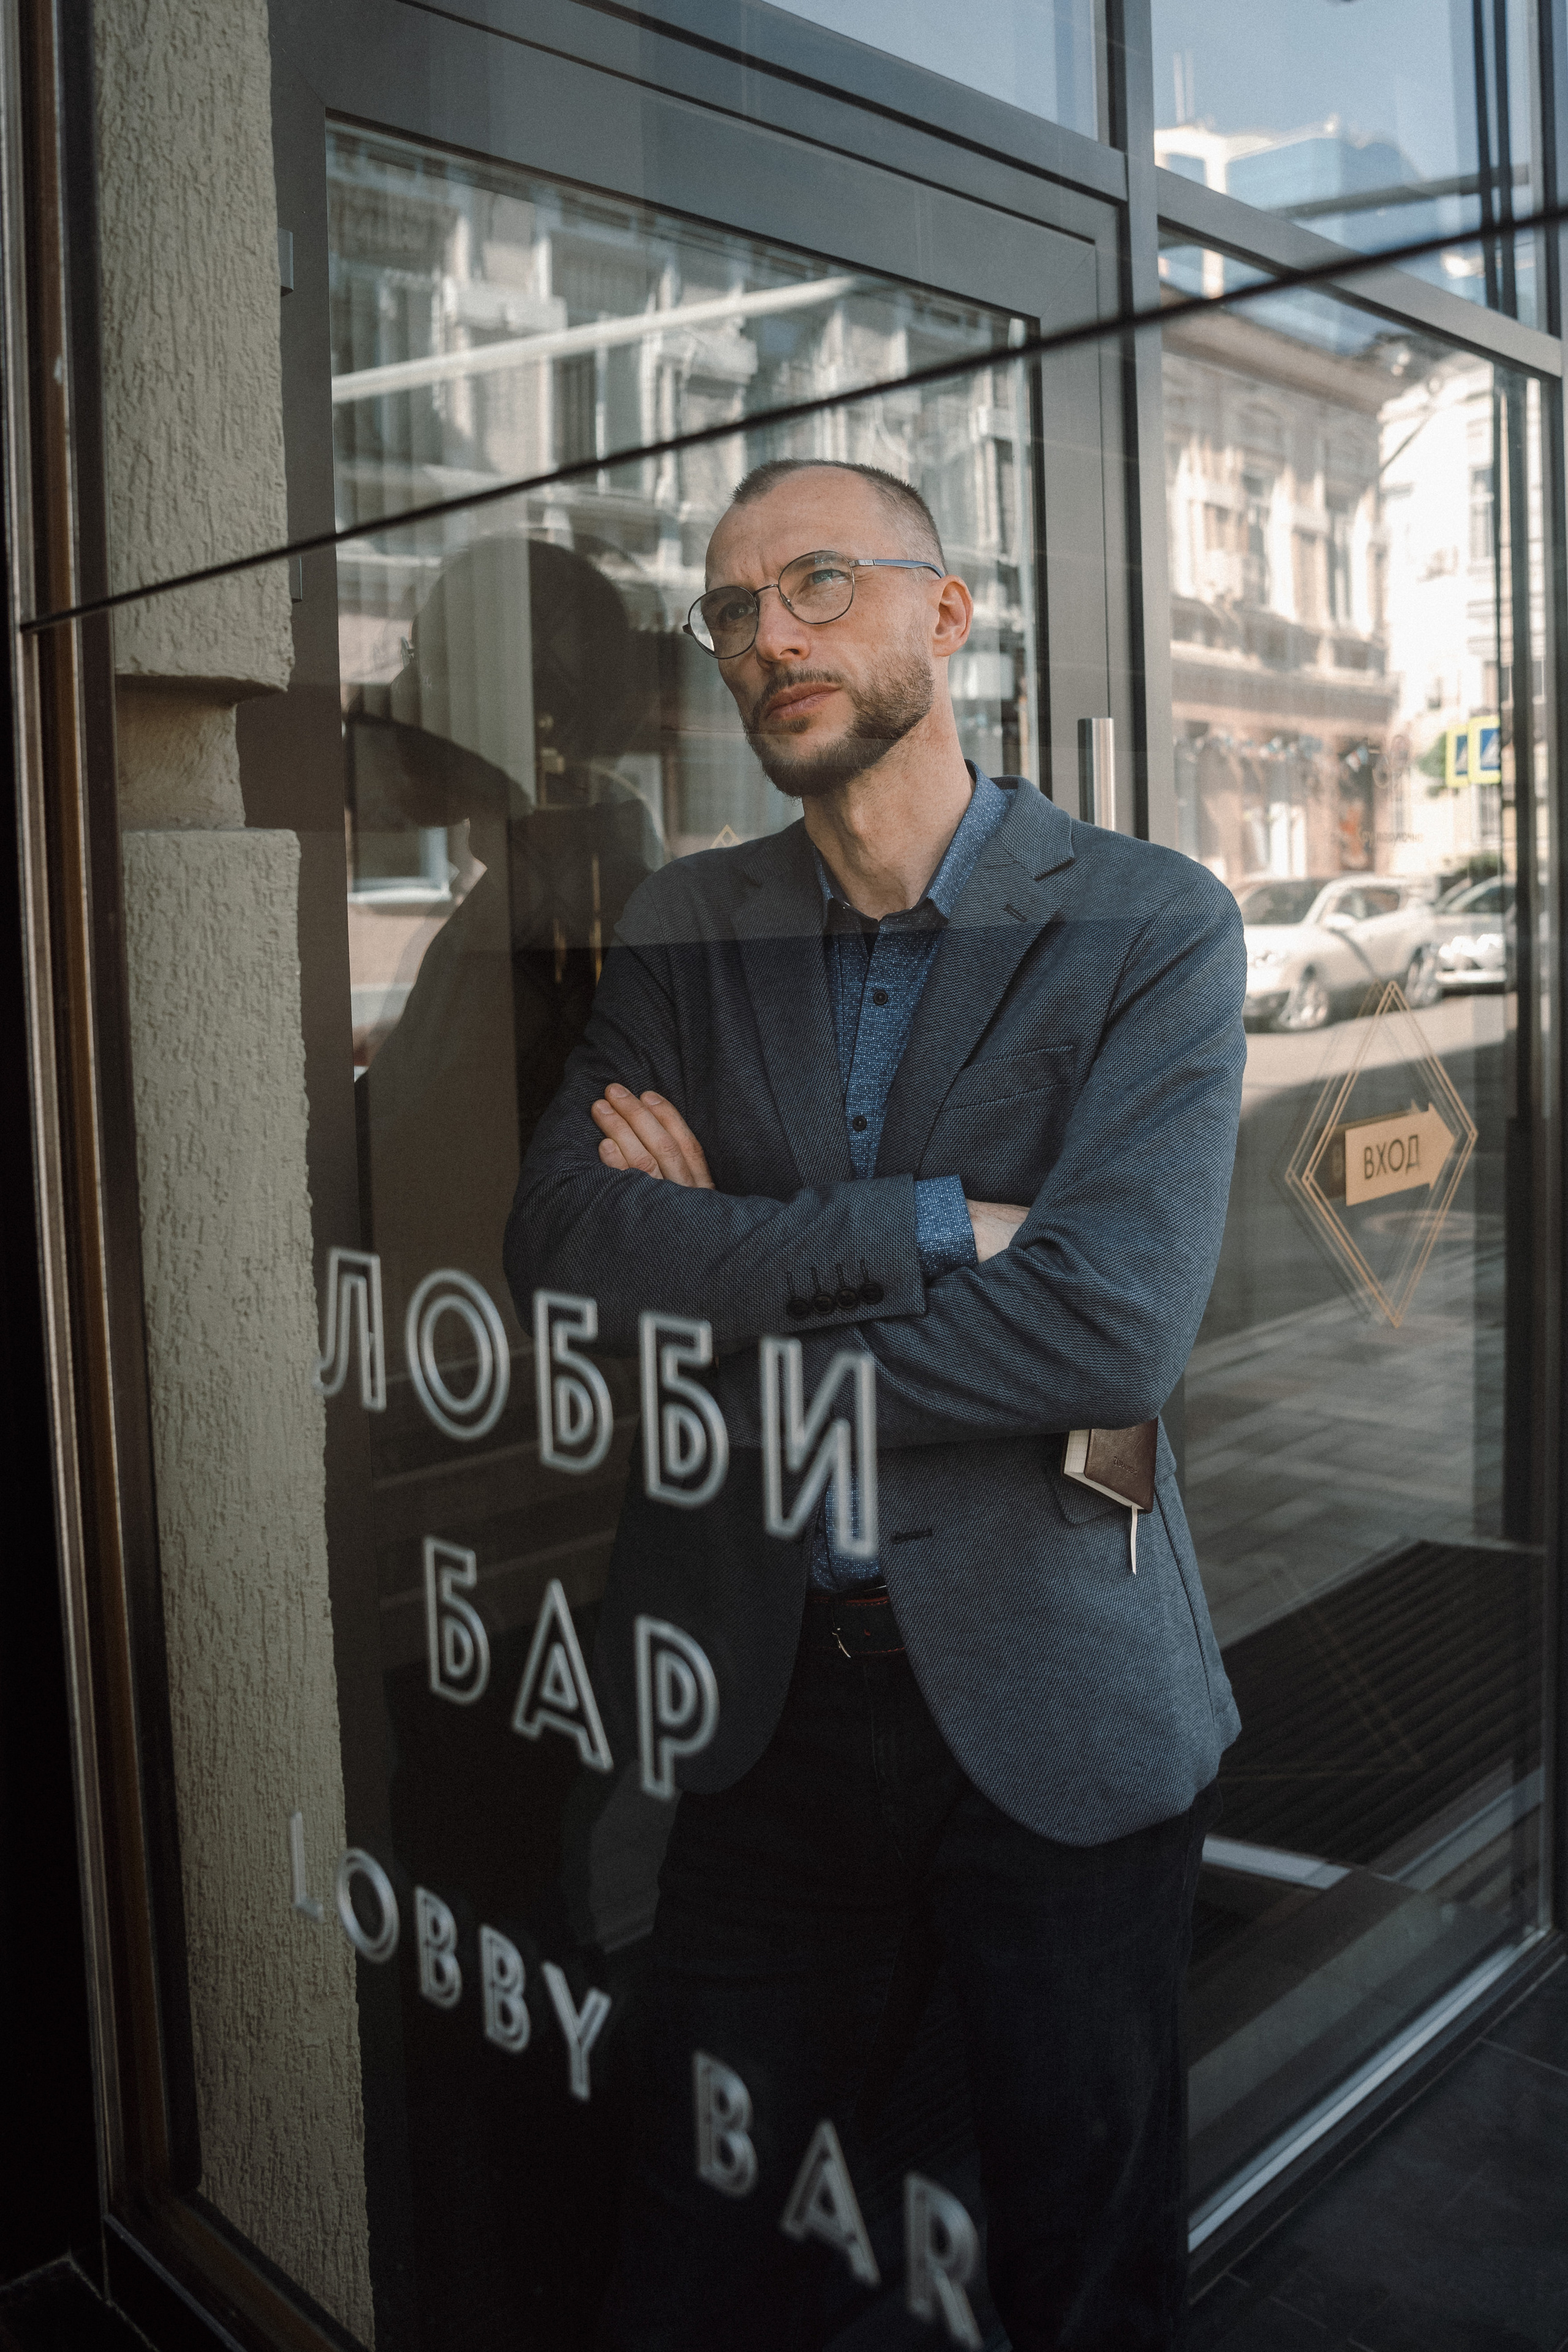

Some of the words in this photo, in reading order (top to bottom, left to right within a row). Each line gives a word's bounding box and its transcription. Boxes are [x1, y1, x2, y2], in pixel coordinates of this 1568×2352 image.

[1364, 1134, 1420, 1180] ВХОД
[313, 1247, 878, 1559] ЛОББИ
[423, 1536, 720, 1801] БАР
[290, 1811, 611, 2101] LOBBY
[693, 2050, 982, 2350] BAR
